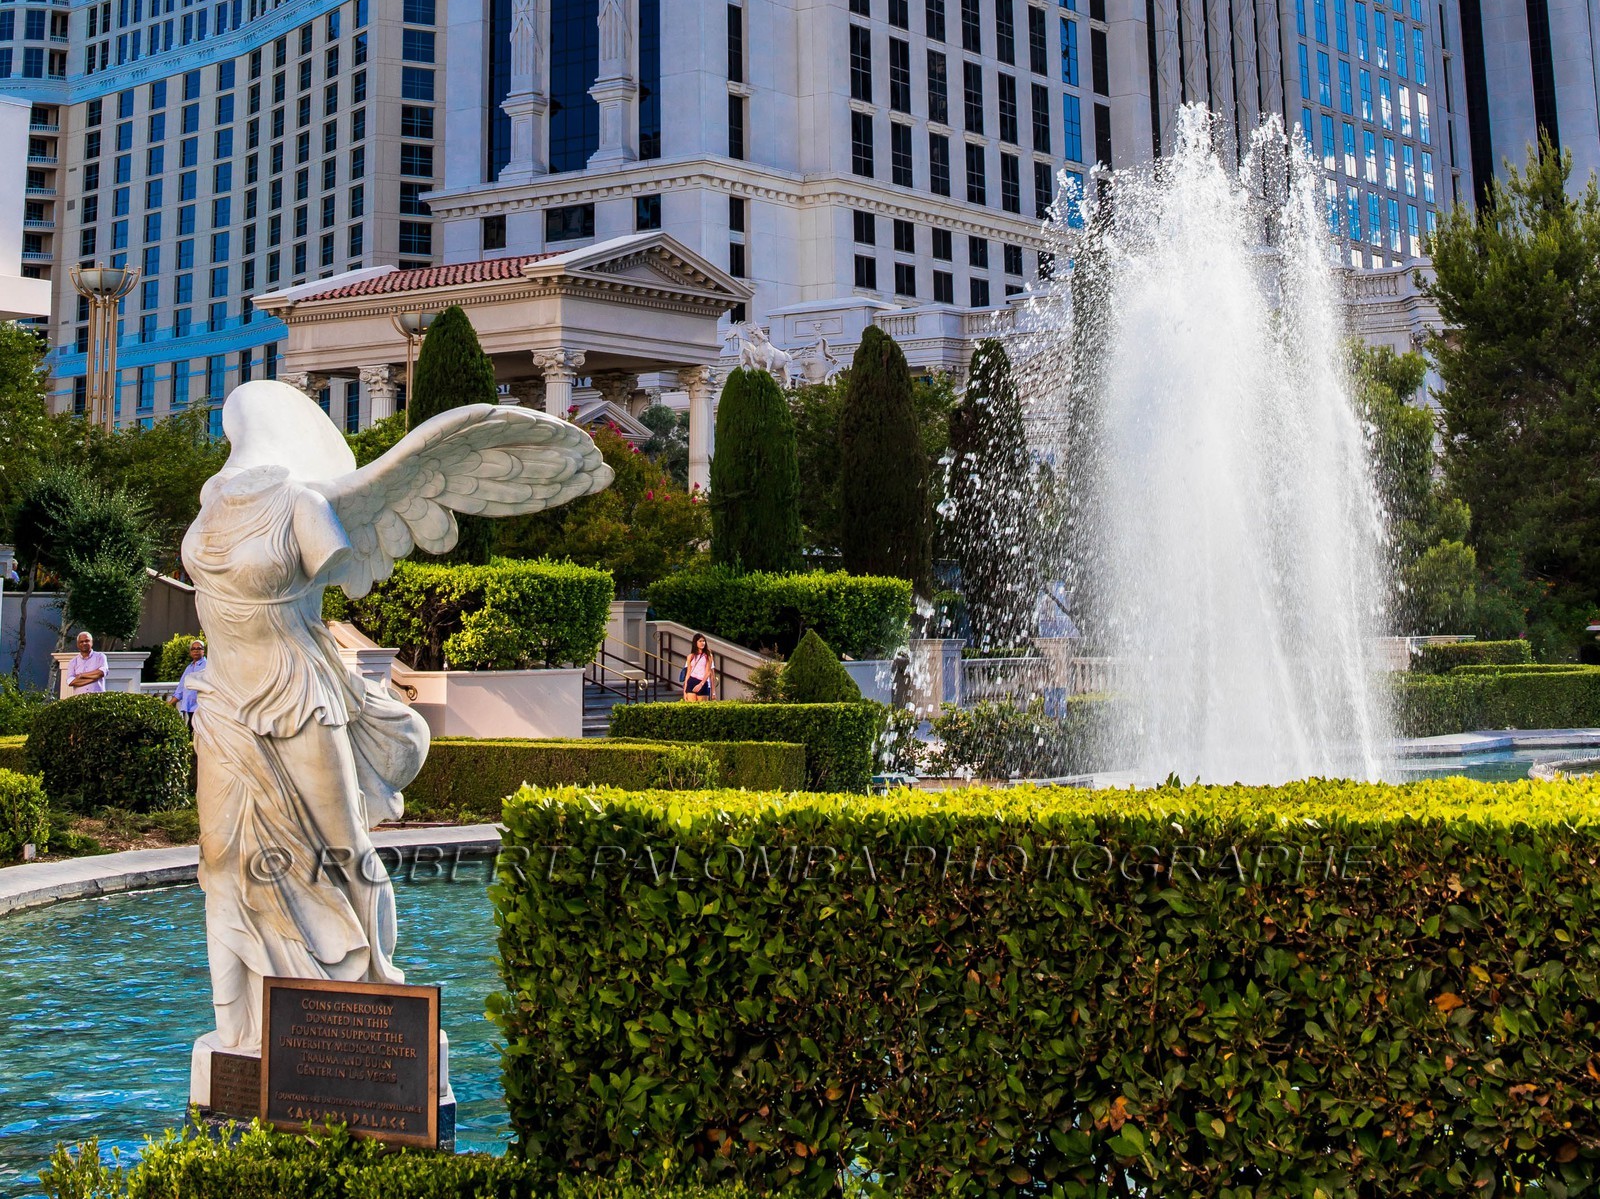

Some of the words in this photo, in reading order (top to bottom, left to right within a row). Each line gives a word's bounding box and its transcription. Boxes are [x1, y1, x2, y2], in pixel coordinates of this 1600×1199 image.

[302, 998, 330, 1010] COINS
[334, 1002, 393, 1016] GENEROUSLY
[306, 1014, 350, 1025] DONATED
[353, 1018, 363, 1026] IN
[367, 1018, 388, 1028] THIS
[292, 1025, 338, 1037] FOUNTAIN
[342, 1030, 381, 1041] SUPPORT
[385, 1033, 403, 1043] THE
[280, 1035, 332, 1050] UNIVERSITY
[335, 1042, 376, 1054] MEDICAL
[379, 1044, 416, 1058] CENTER
[302, 1052, 338, 1064] TRAUMA
[342, 1058, 361, 1066] AND
[366, 1058, 392, 1069] BURN
[296, 1064, 330, 1076] CENTER
[335, 1069, 345, 1078] IN
[350, 1070, 364, 1080] LAS
[367, 1071, 397, 1083] VEGAS
[275, 1091, 308, 1102] FOUNTAINS
[353, 1112, 406, 1130] PALACE
